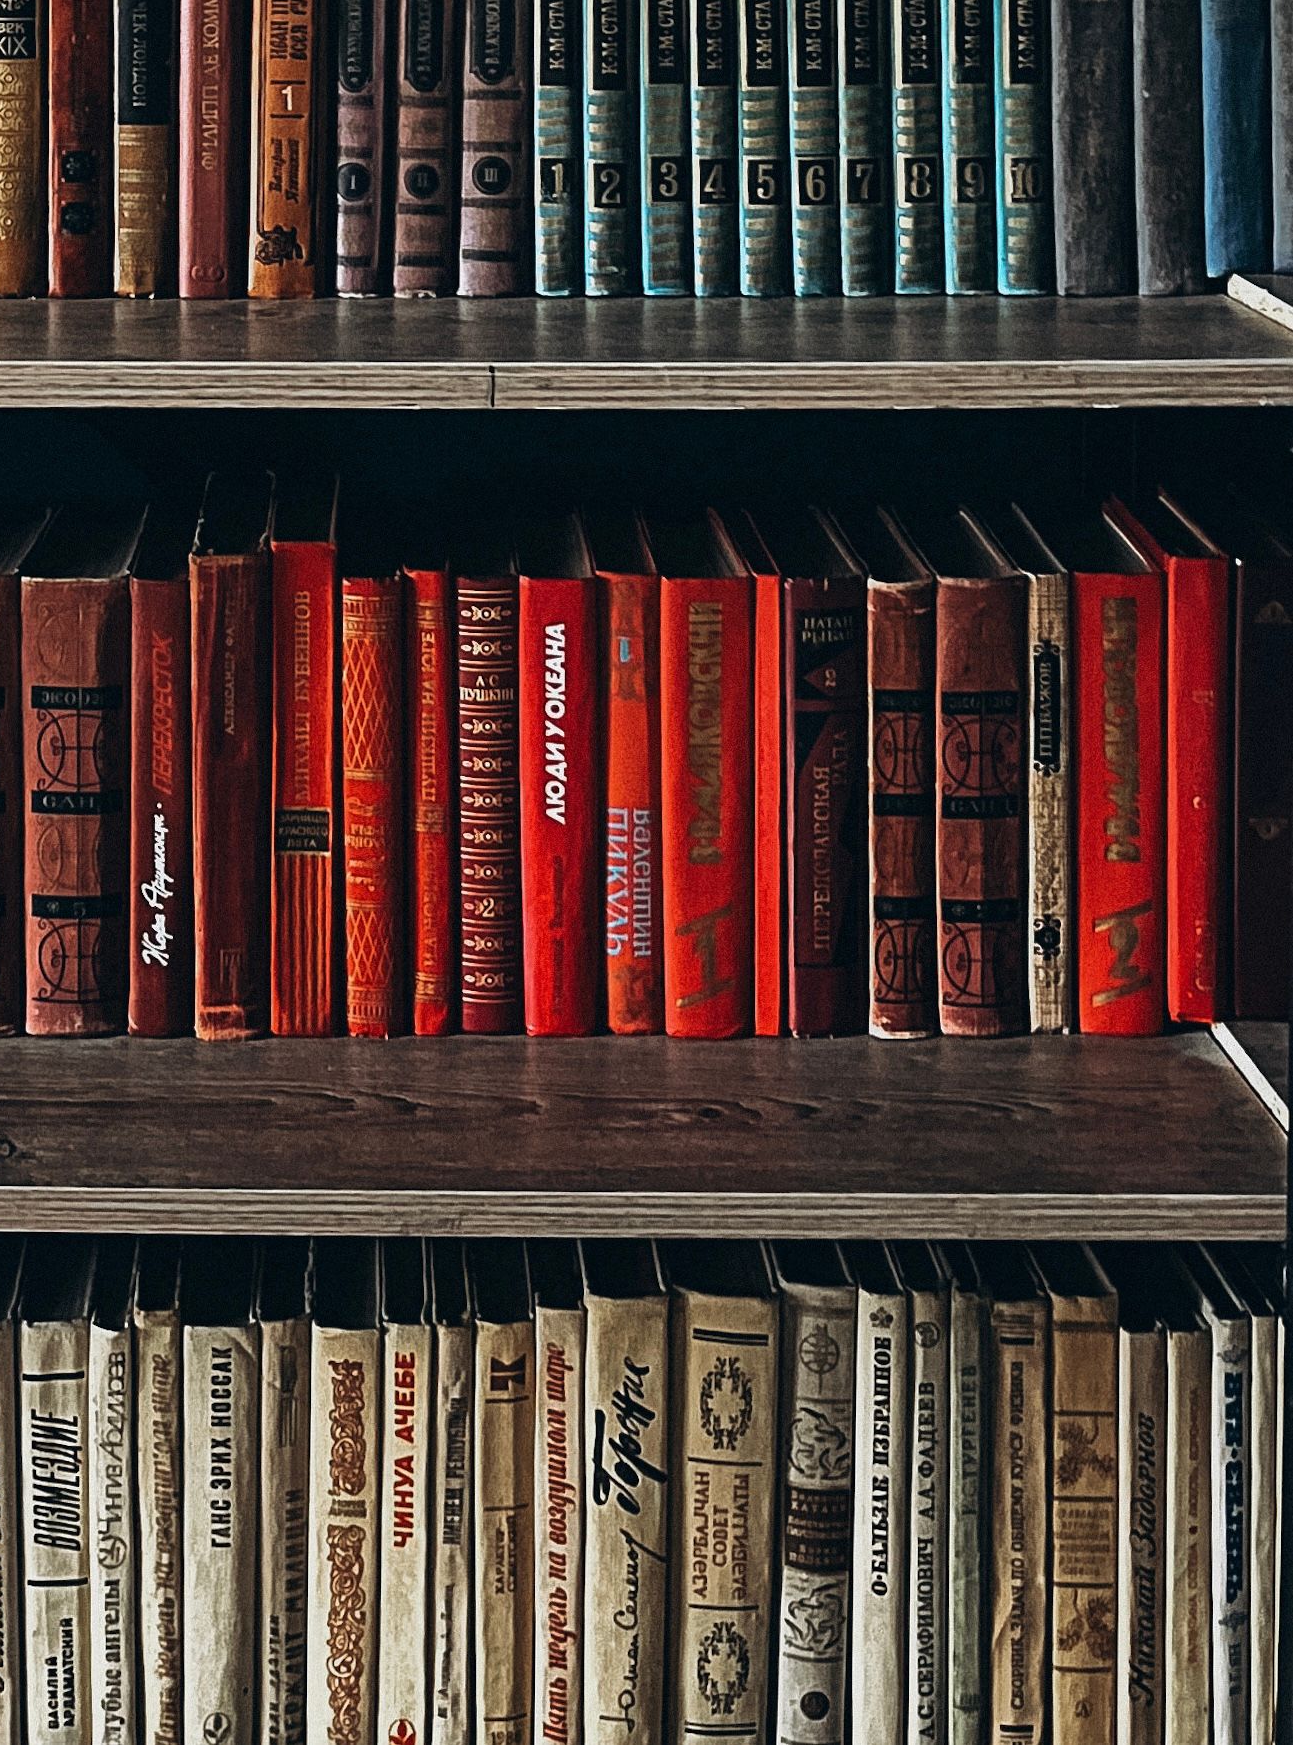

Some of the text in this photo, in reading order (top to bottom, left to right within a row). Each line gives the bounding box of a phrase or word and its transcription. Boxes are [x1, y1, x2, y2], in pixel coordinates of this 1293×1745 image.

[805, 165, 826, 200] 6
[1011, 163, 1043, 198] 10
[152, 631, 173, 794] ПЕРЕКРЕСТОК
[421, 632, 438, 801] ПУШКИН НА ЮГЕ
[545, 623, 567, 825] ЛЮДИ У ОКЕАНА
[607, 806, 630, 957] ПИКУЛЬ
[813, 766, 831, 951] ПЕРЕЯСЛАВСКАЯ
[546, 1342, 573, 1402] шаре
[873, 1337, 892, 1466] ИЗБРАННОЕ
[31, 1410, 82, 1551] ВОЗМЕЗДИЕ
[211, 1346, 232, 1548] ГАНС ЭРИХ НОССАК
[394, 1351, 415, 1548] ЧИНУА АЧЕБЕ
[547, 1410, 575, 1546] воздушном
[1010, 1431, 1024, 1480] КУРСУ
[549, 1553, 567, 1581] на
[918, 1382, 937, 1692] СЕРАФИМОВИЧ ФАДЕЕВ
[1010, 1485, 1024, 1552] ОБЩЕМУ
[1010, 1556, 1024, 1579] ПО
[60, 1618, 75, 1727] АРДАМАТСКИЙ
[548, 1588, 576, 1670] недель
[1011, 1635, 1025, 1710] СБОРНИК
[45, 1656, 59, 1729] ВАСИЛИЙ
